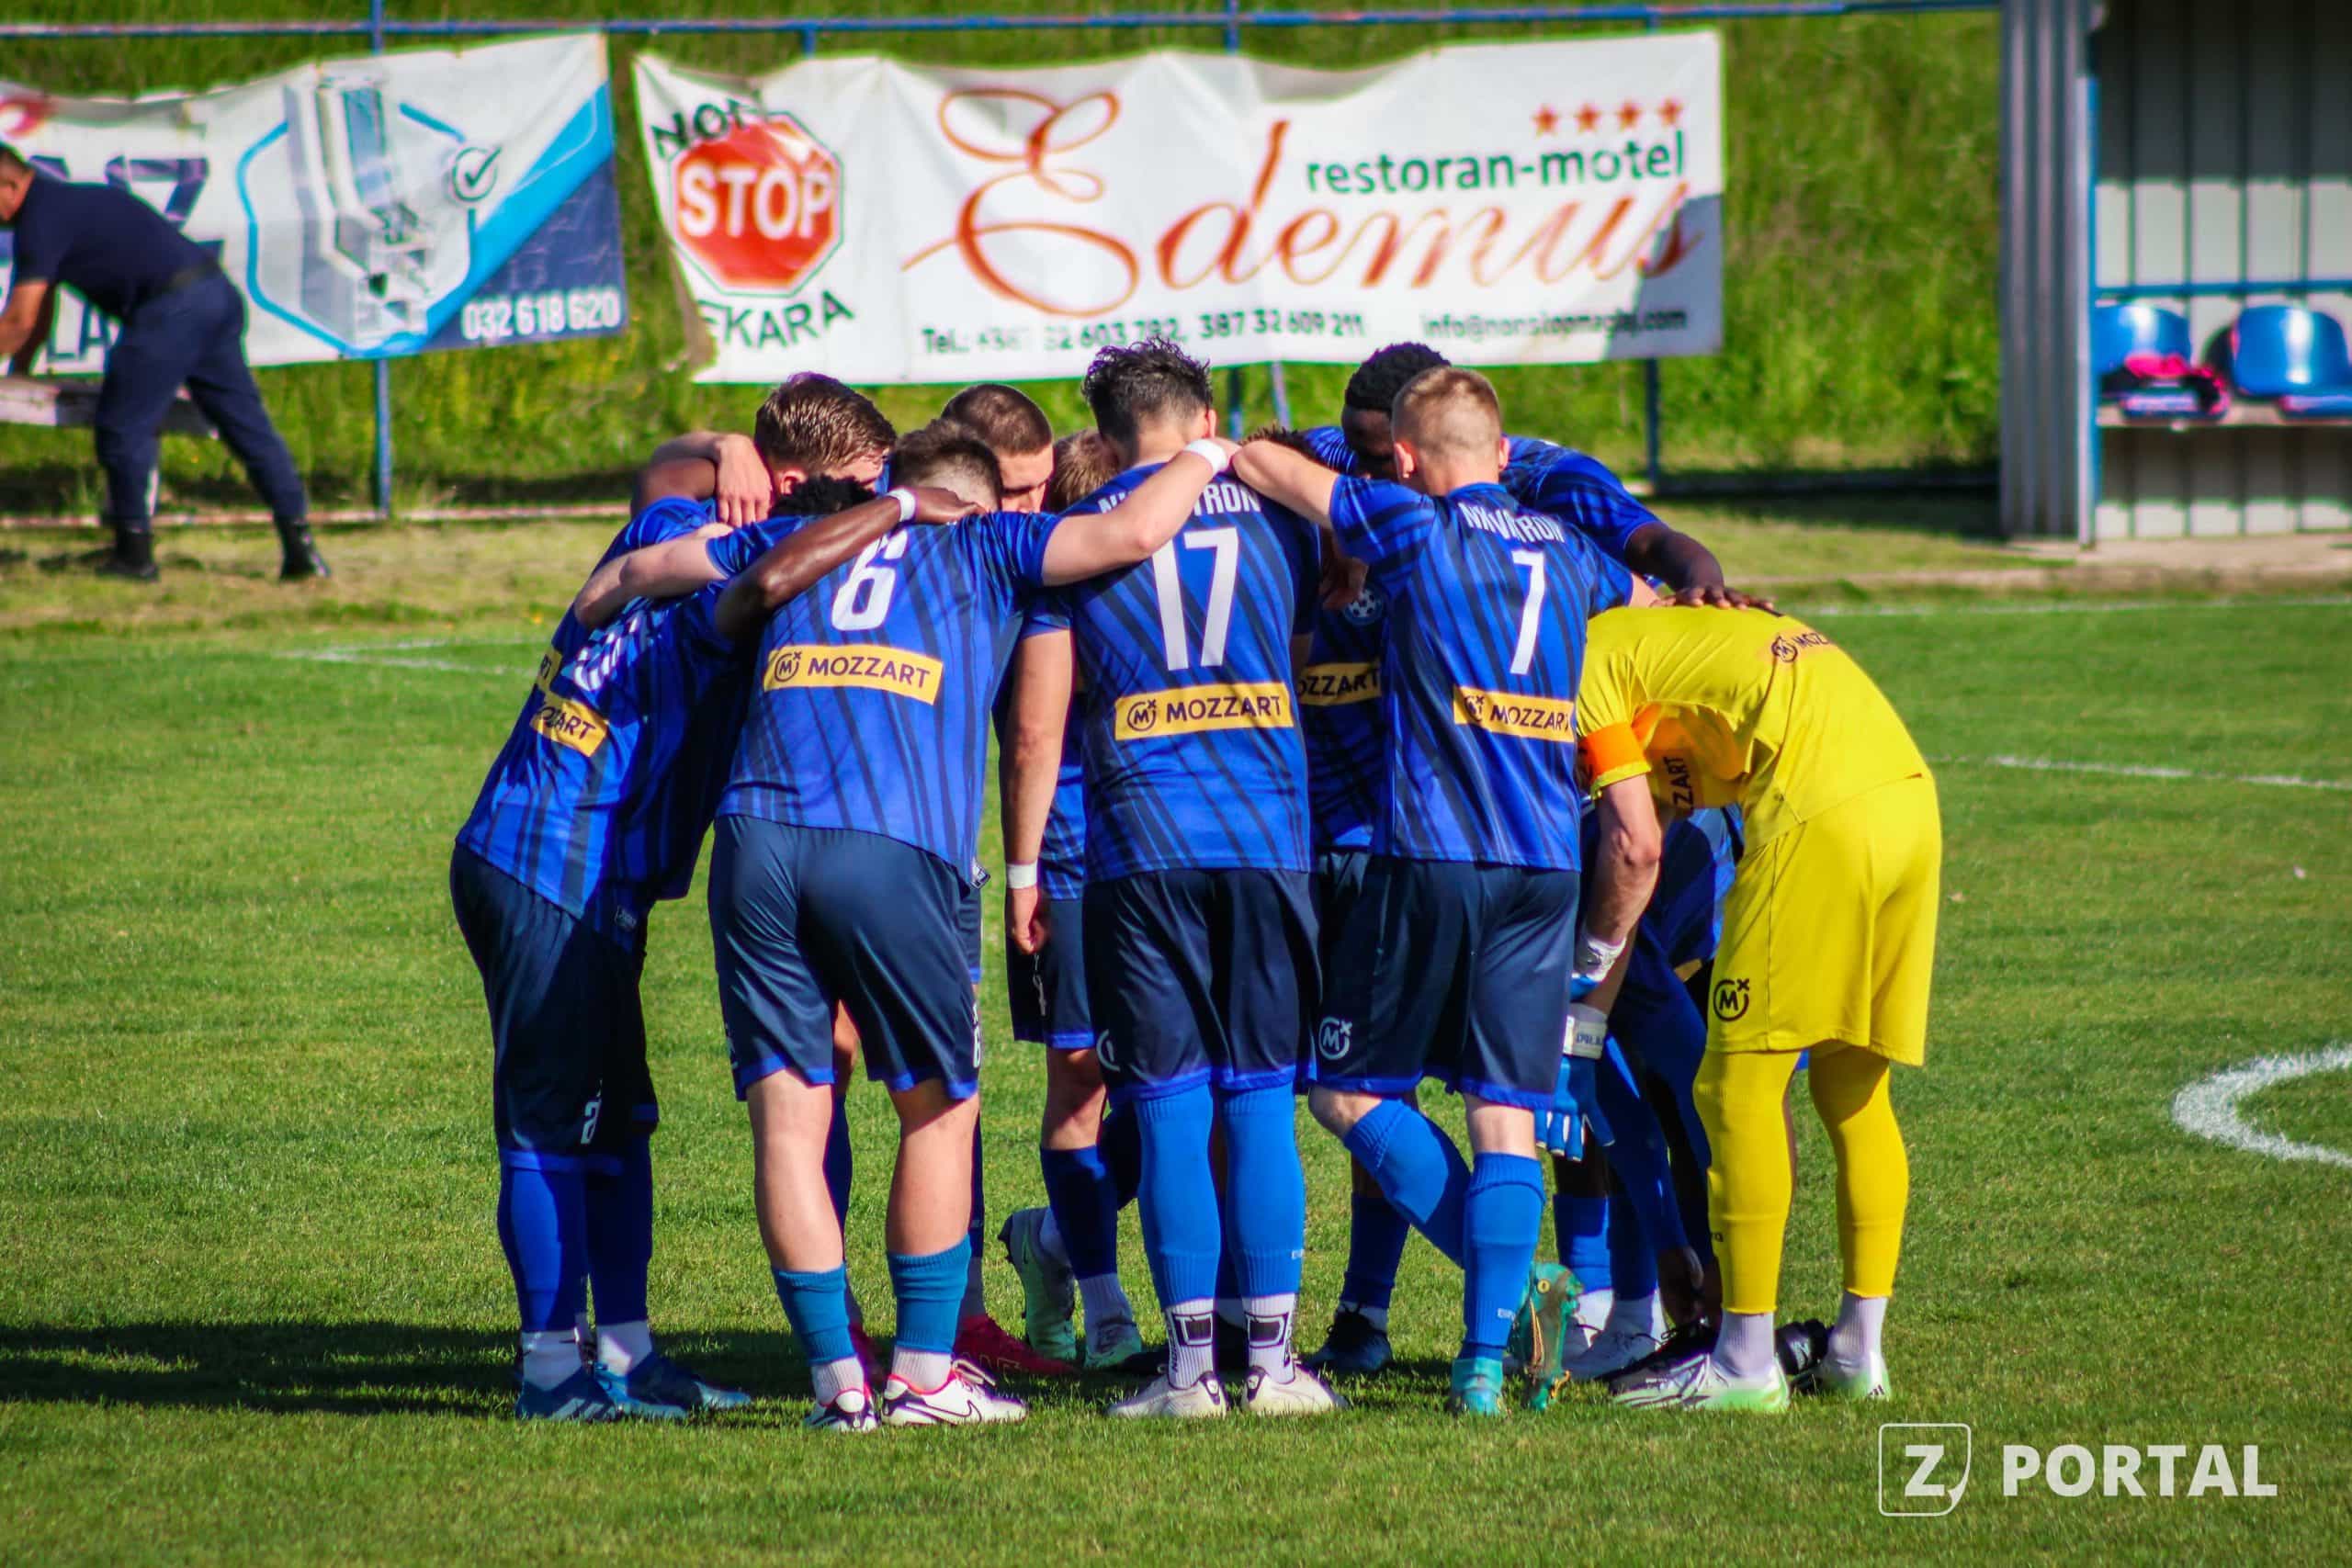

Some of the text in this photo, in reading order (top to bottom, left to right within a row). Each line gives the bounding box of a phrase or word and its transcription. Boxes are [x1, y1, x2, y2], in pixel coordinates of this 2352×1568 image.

[1306, 129, 1685, 194] restoran-motel
[679, 158, 835, 239] STOP
[461, 286, 622, 341] 032 618 620
[1199, 311, 1245, 339] 387
[831, 529, 909, 632] 6
[1150, 525, 1239, 671] 17
[1510, 550, 1545, 675] 7
[808, 656, 930, 689] MOZZART
[1166, 695, 1282, 724] MOZZART
